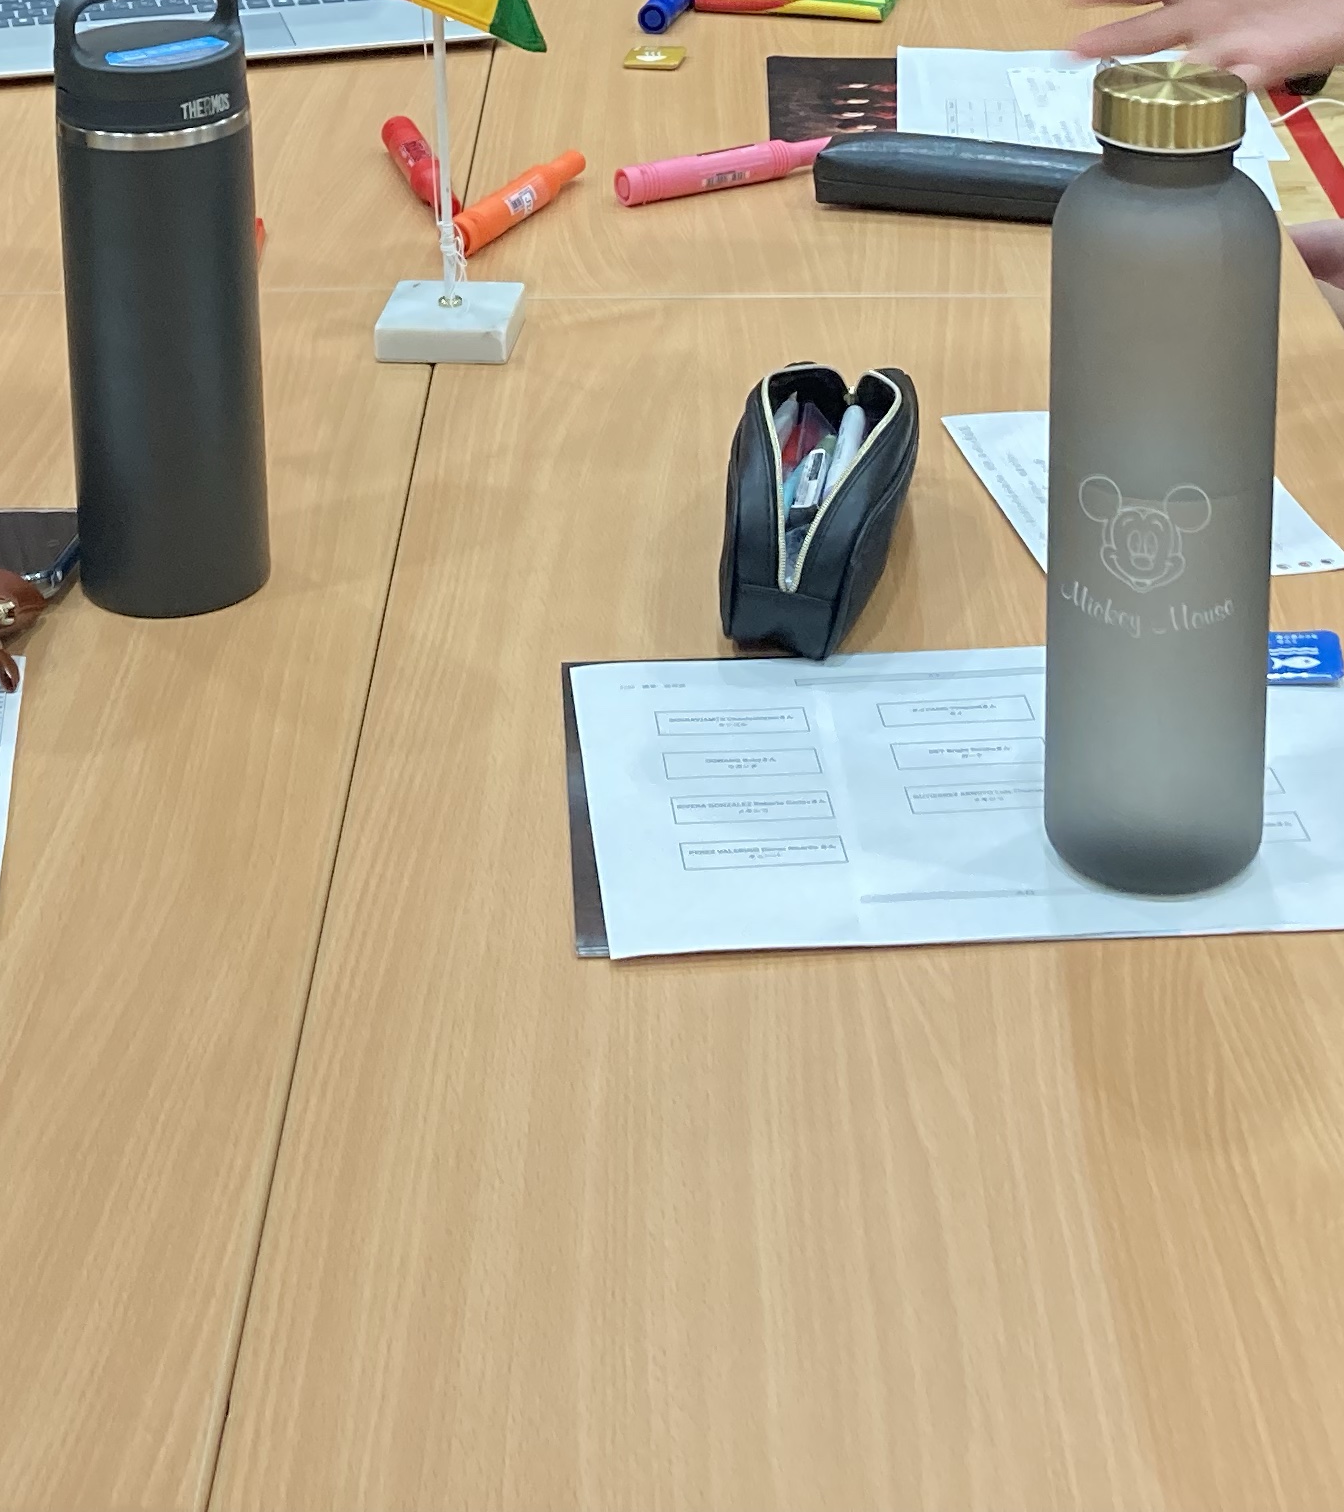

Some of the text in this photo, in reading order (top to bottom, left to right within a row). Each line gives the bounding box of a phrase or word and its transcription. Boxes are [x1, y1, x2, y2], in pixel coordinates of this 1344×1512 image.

[179, 93, 231, 120] THERMOS
[1060, 580, 1234, 638] Mickey Mouse
